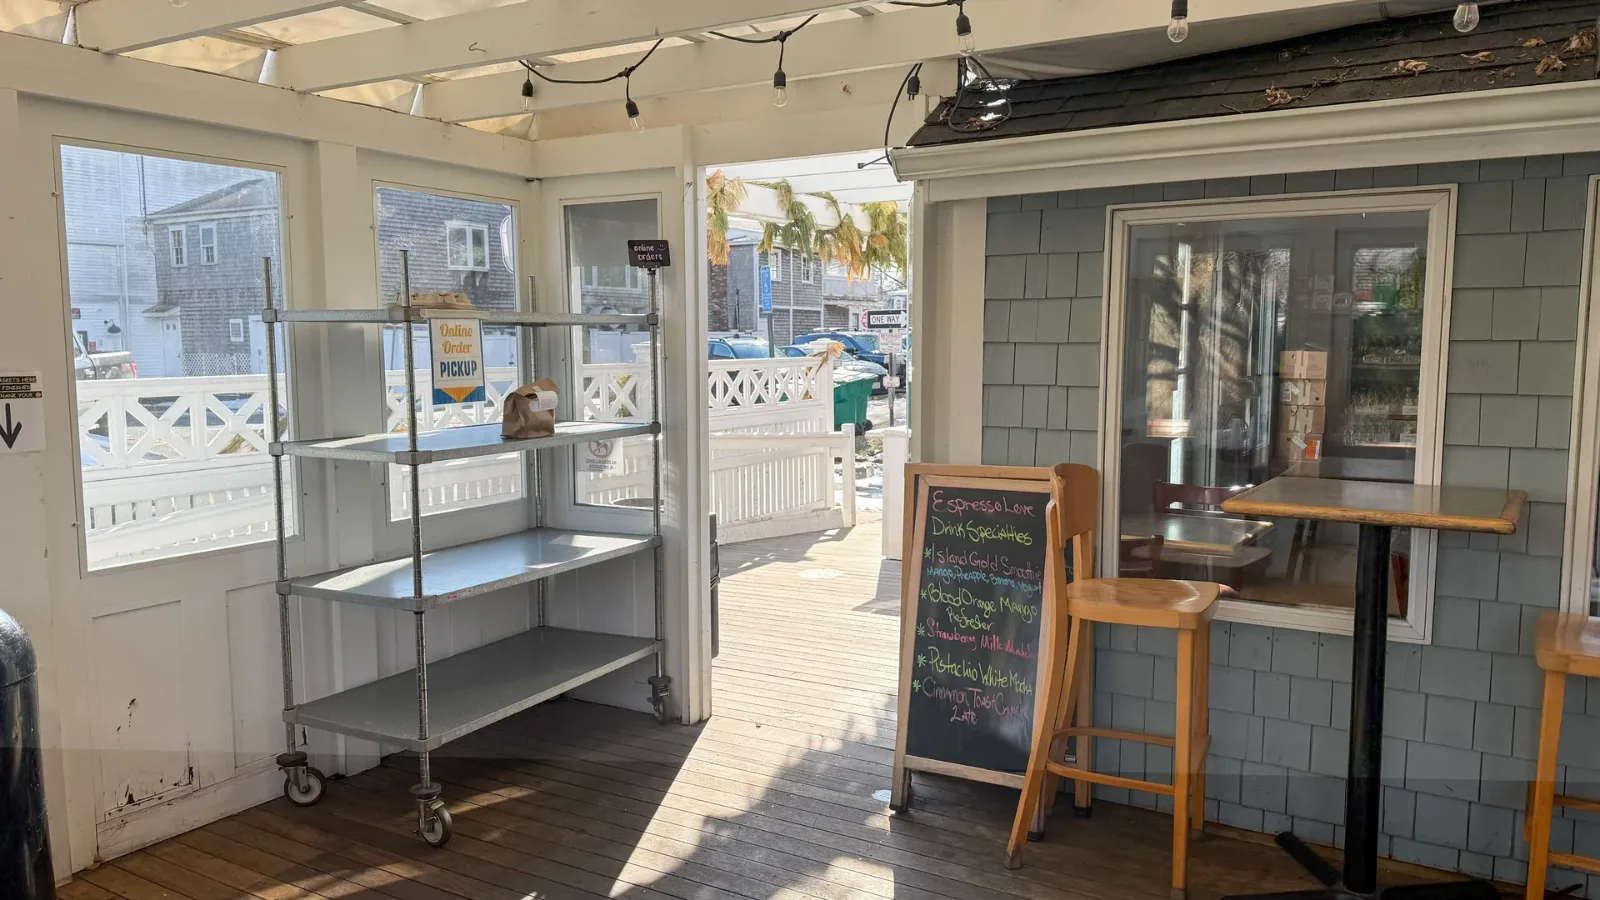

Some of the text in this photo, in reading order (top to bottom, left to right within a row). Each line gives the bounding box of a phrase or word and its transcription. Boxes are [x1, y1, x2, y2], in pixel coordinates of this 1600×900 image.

[633, 244, 655, 252] online
[637, 253, 663, 261] orders
[871, 315, 900, 324] ONE WAY
[440, 324, 472, 337] Online
[442, 340, 472, 354] Order
[440, 361, 477, 377] PICKUP
[932, 490, 1036, 517] Espresso Love
[931, 516, 1033, 546] Drink Specialties
[932, 543, 1042, 582] Island Gold Smoothie
[928, 582, 1038, 624] Blood Orange Mango
[980, 634, 1002, 650] Milk
[928, 646, 979, 681] Pistachio
[978, 661, 1009, 688] White
[922, 676, 970, 706] Cinnamon
[966, 687, 996, 709] Toast
